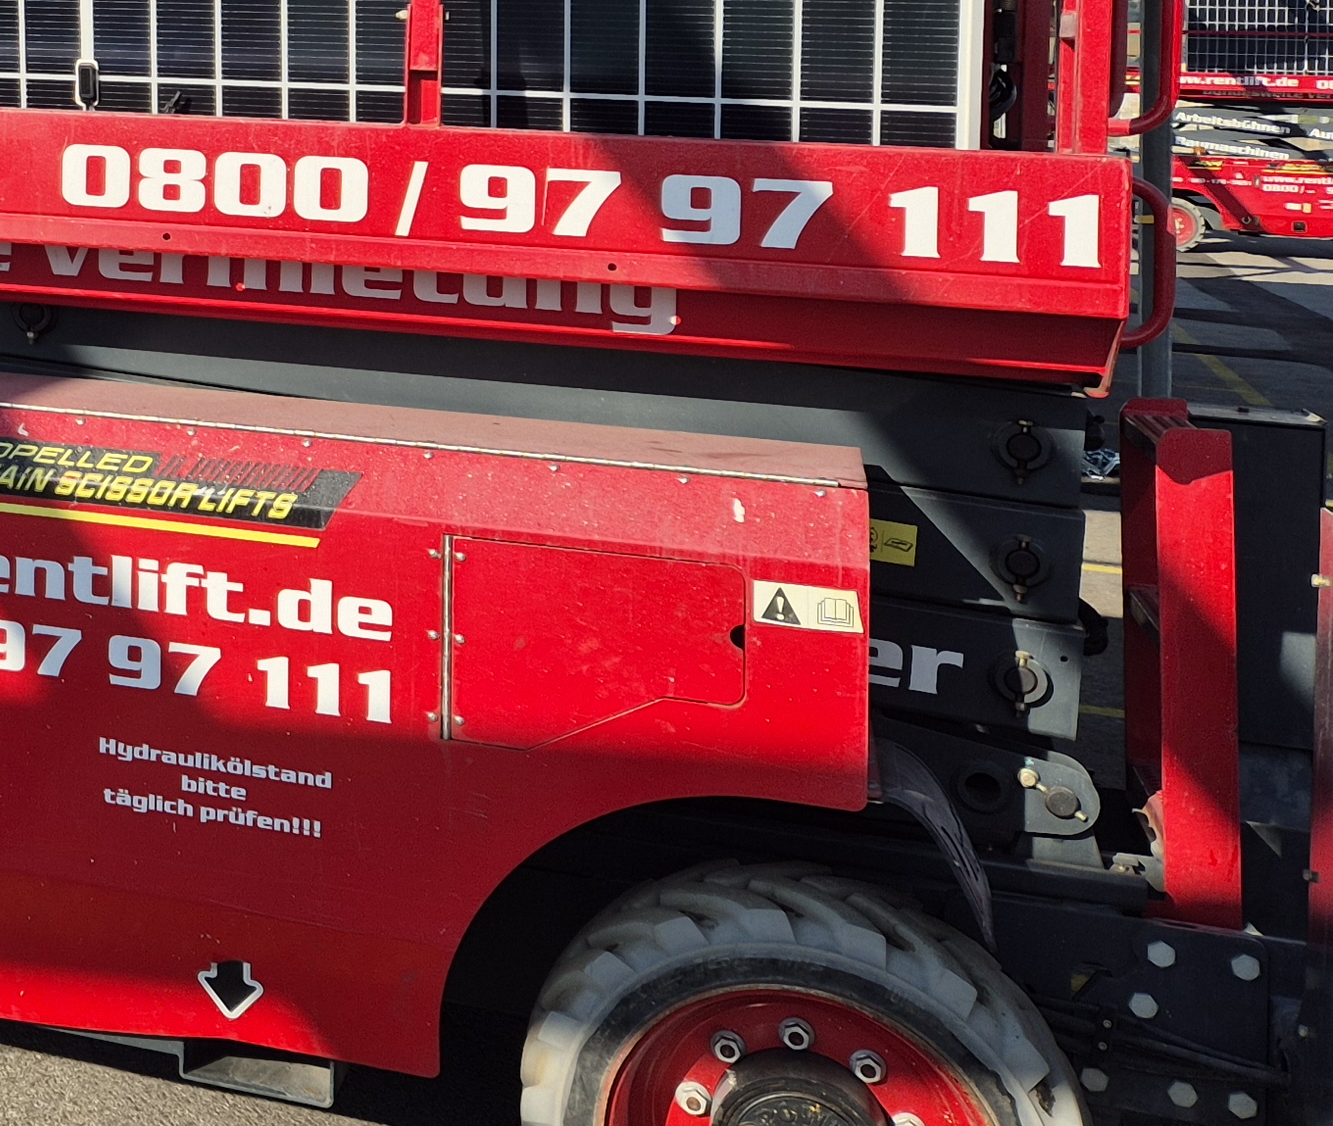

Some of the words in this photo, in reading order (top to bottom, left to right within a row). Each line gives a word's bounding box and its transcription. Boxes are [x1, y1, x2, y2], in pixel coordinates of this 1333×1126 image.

[61, 143, 369, 223] 0800
[395, 160, 429, 237] /
[459, 164, 622, 237] 97
[660, 174, 834, 250] 97
[889, 186, 1101, 269] 111
[108, 634, 222, 697] 97
[257, 656, 392, 724] 111
[99, 736, 332, 789] Hydraulikölstand
[181, 774, 247, 801] bitte
[103, 788, 194, 817] täglich
[199, 806, 321, 838] prüfen!!!
